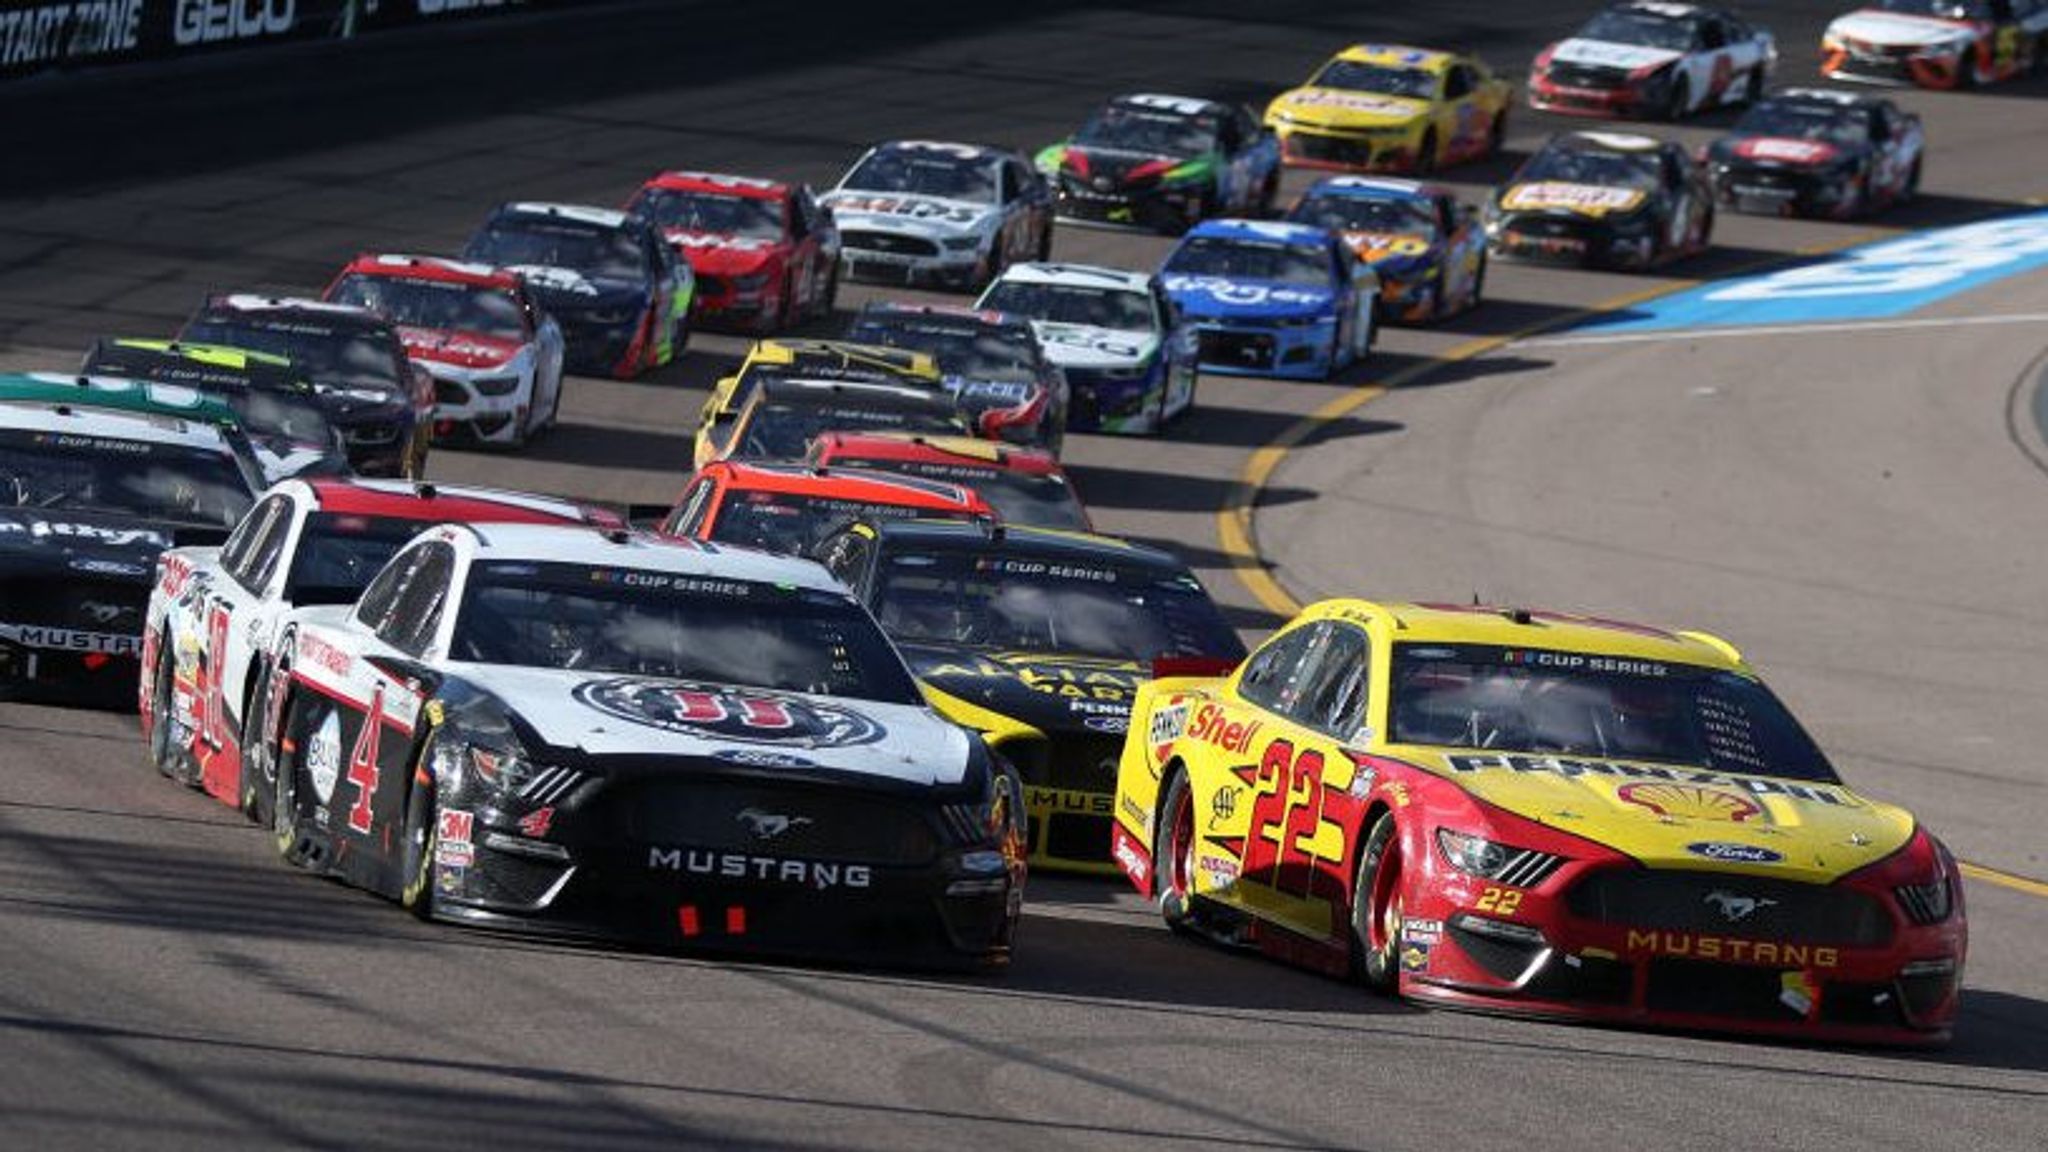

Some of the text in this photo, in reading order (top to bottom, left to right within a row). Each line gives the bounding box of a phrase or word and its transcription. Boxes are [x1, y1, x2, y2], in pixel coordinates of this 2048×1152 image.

[174, 0, 297, 44] GEICO
[623, 572, 750, 596] CUP SERIES
[1006, 560, 1117, 584] CUP SERIES
[20, 626, 147, 658] MUSTA
[1537, 653, 1669, 677] CUP SERIES
[1187, 703, 1264, 755] Shell
[347, 679, 380, 835] 4
[441, 811, 471, 840] 3M
[520, 807, 555, 838] 4
[1242, 738, 1325, 900] 22
[649, 846, 872, 889] MUSTANG
[1703, 844, 1766, 861] Ford
[1475, 886, 1523, 915] 22
[1627, 929, 1838, 967] MUSTANG
